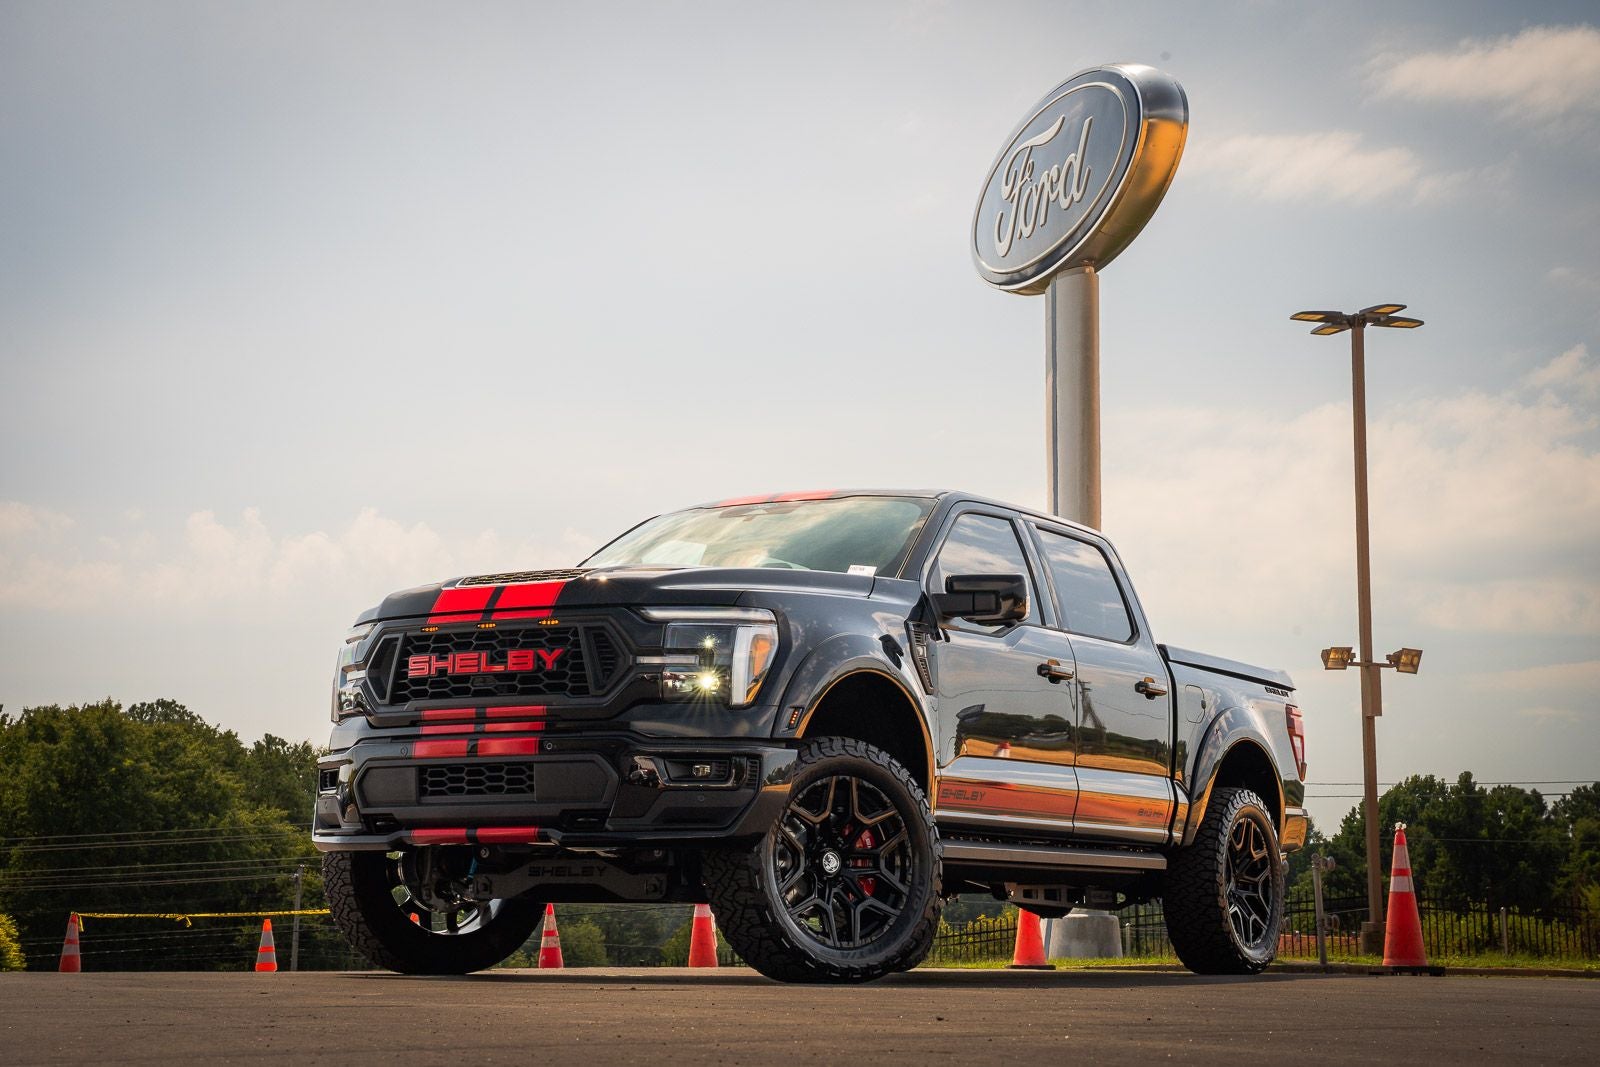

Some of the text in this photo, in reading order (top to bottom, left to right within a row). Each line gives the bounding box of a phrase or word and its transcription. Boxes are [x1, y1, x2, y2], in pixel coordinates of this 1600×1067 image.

[994, 114, 1093, 257] Ford
[408, 649, 564, 679] SHELBY
[941, 788, 986, 801] SHELBY
[528, 865, 608, 877] SHELBY
